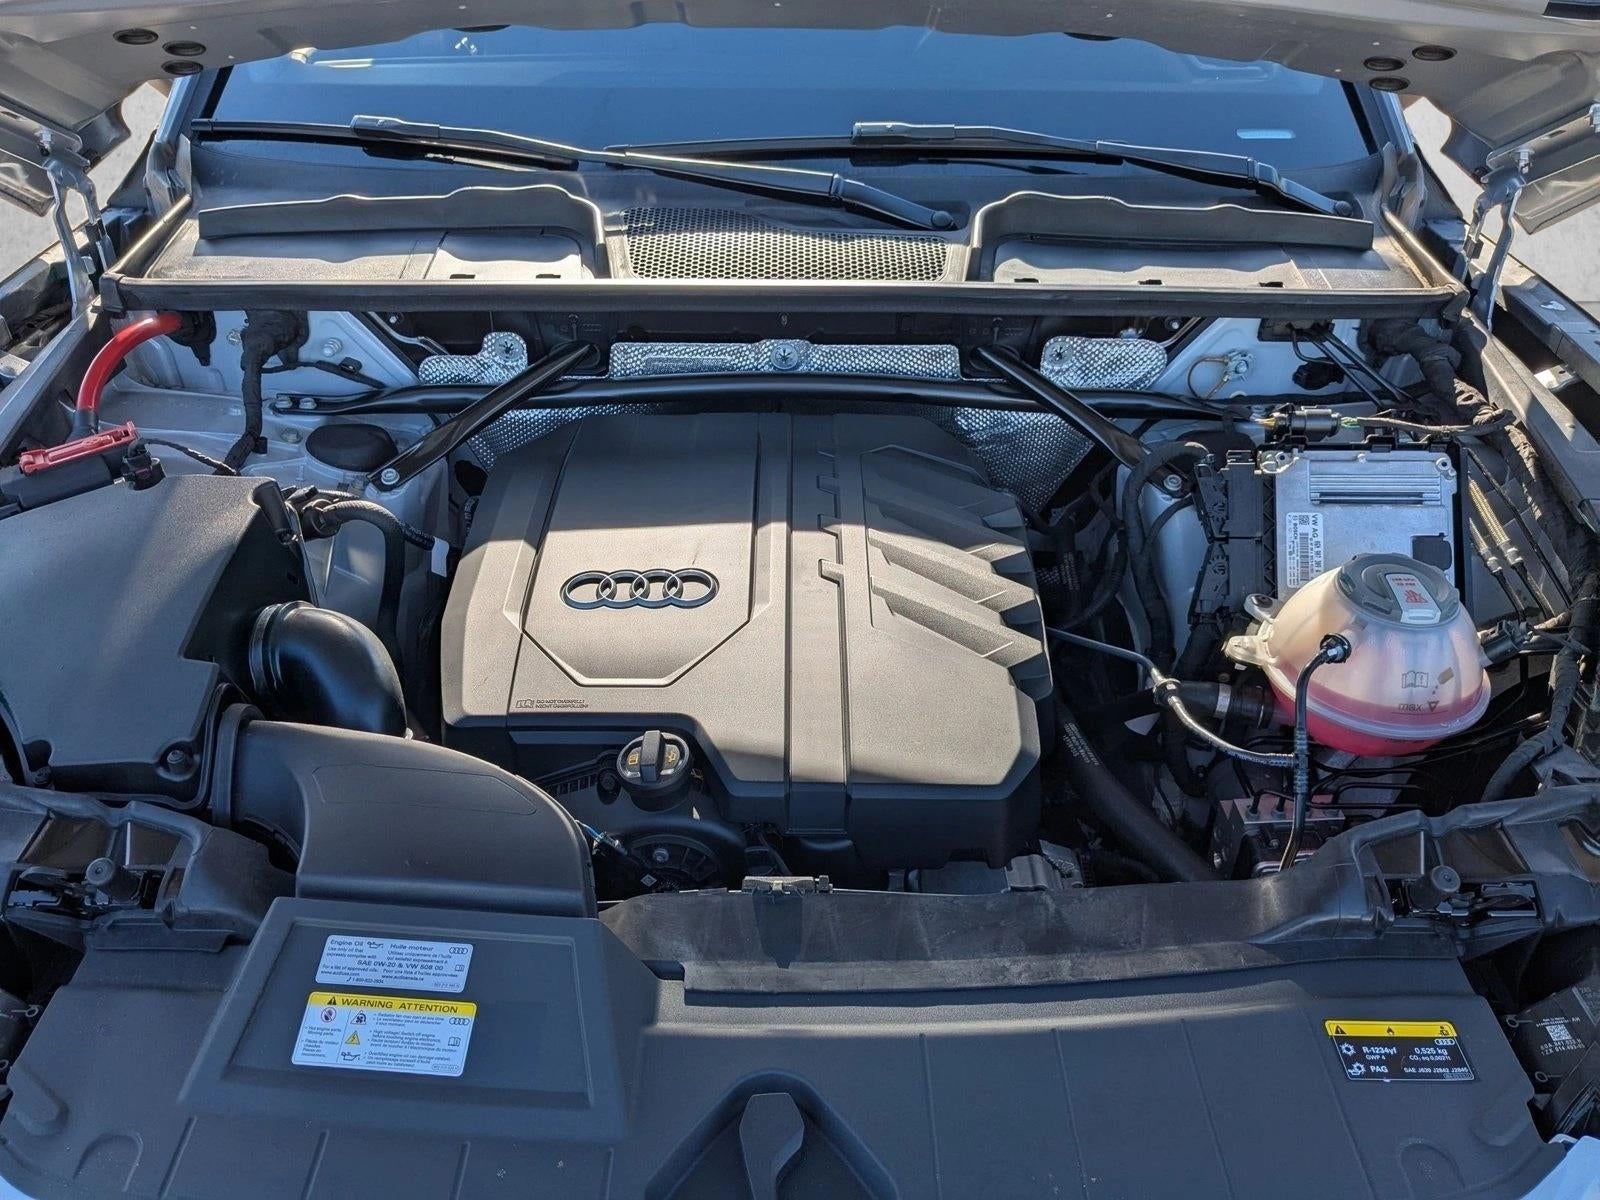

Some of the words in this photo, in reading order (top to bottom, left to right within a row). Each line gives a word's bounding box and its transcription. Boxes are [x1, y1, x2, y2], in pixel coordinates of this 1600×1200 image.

[341, 998, 393, 1009] WARNING
[398, 1002, 458, 1013] ATTENTION
[1362, 1046, 1398, 1055] R-1234yf
